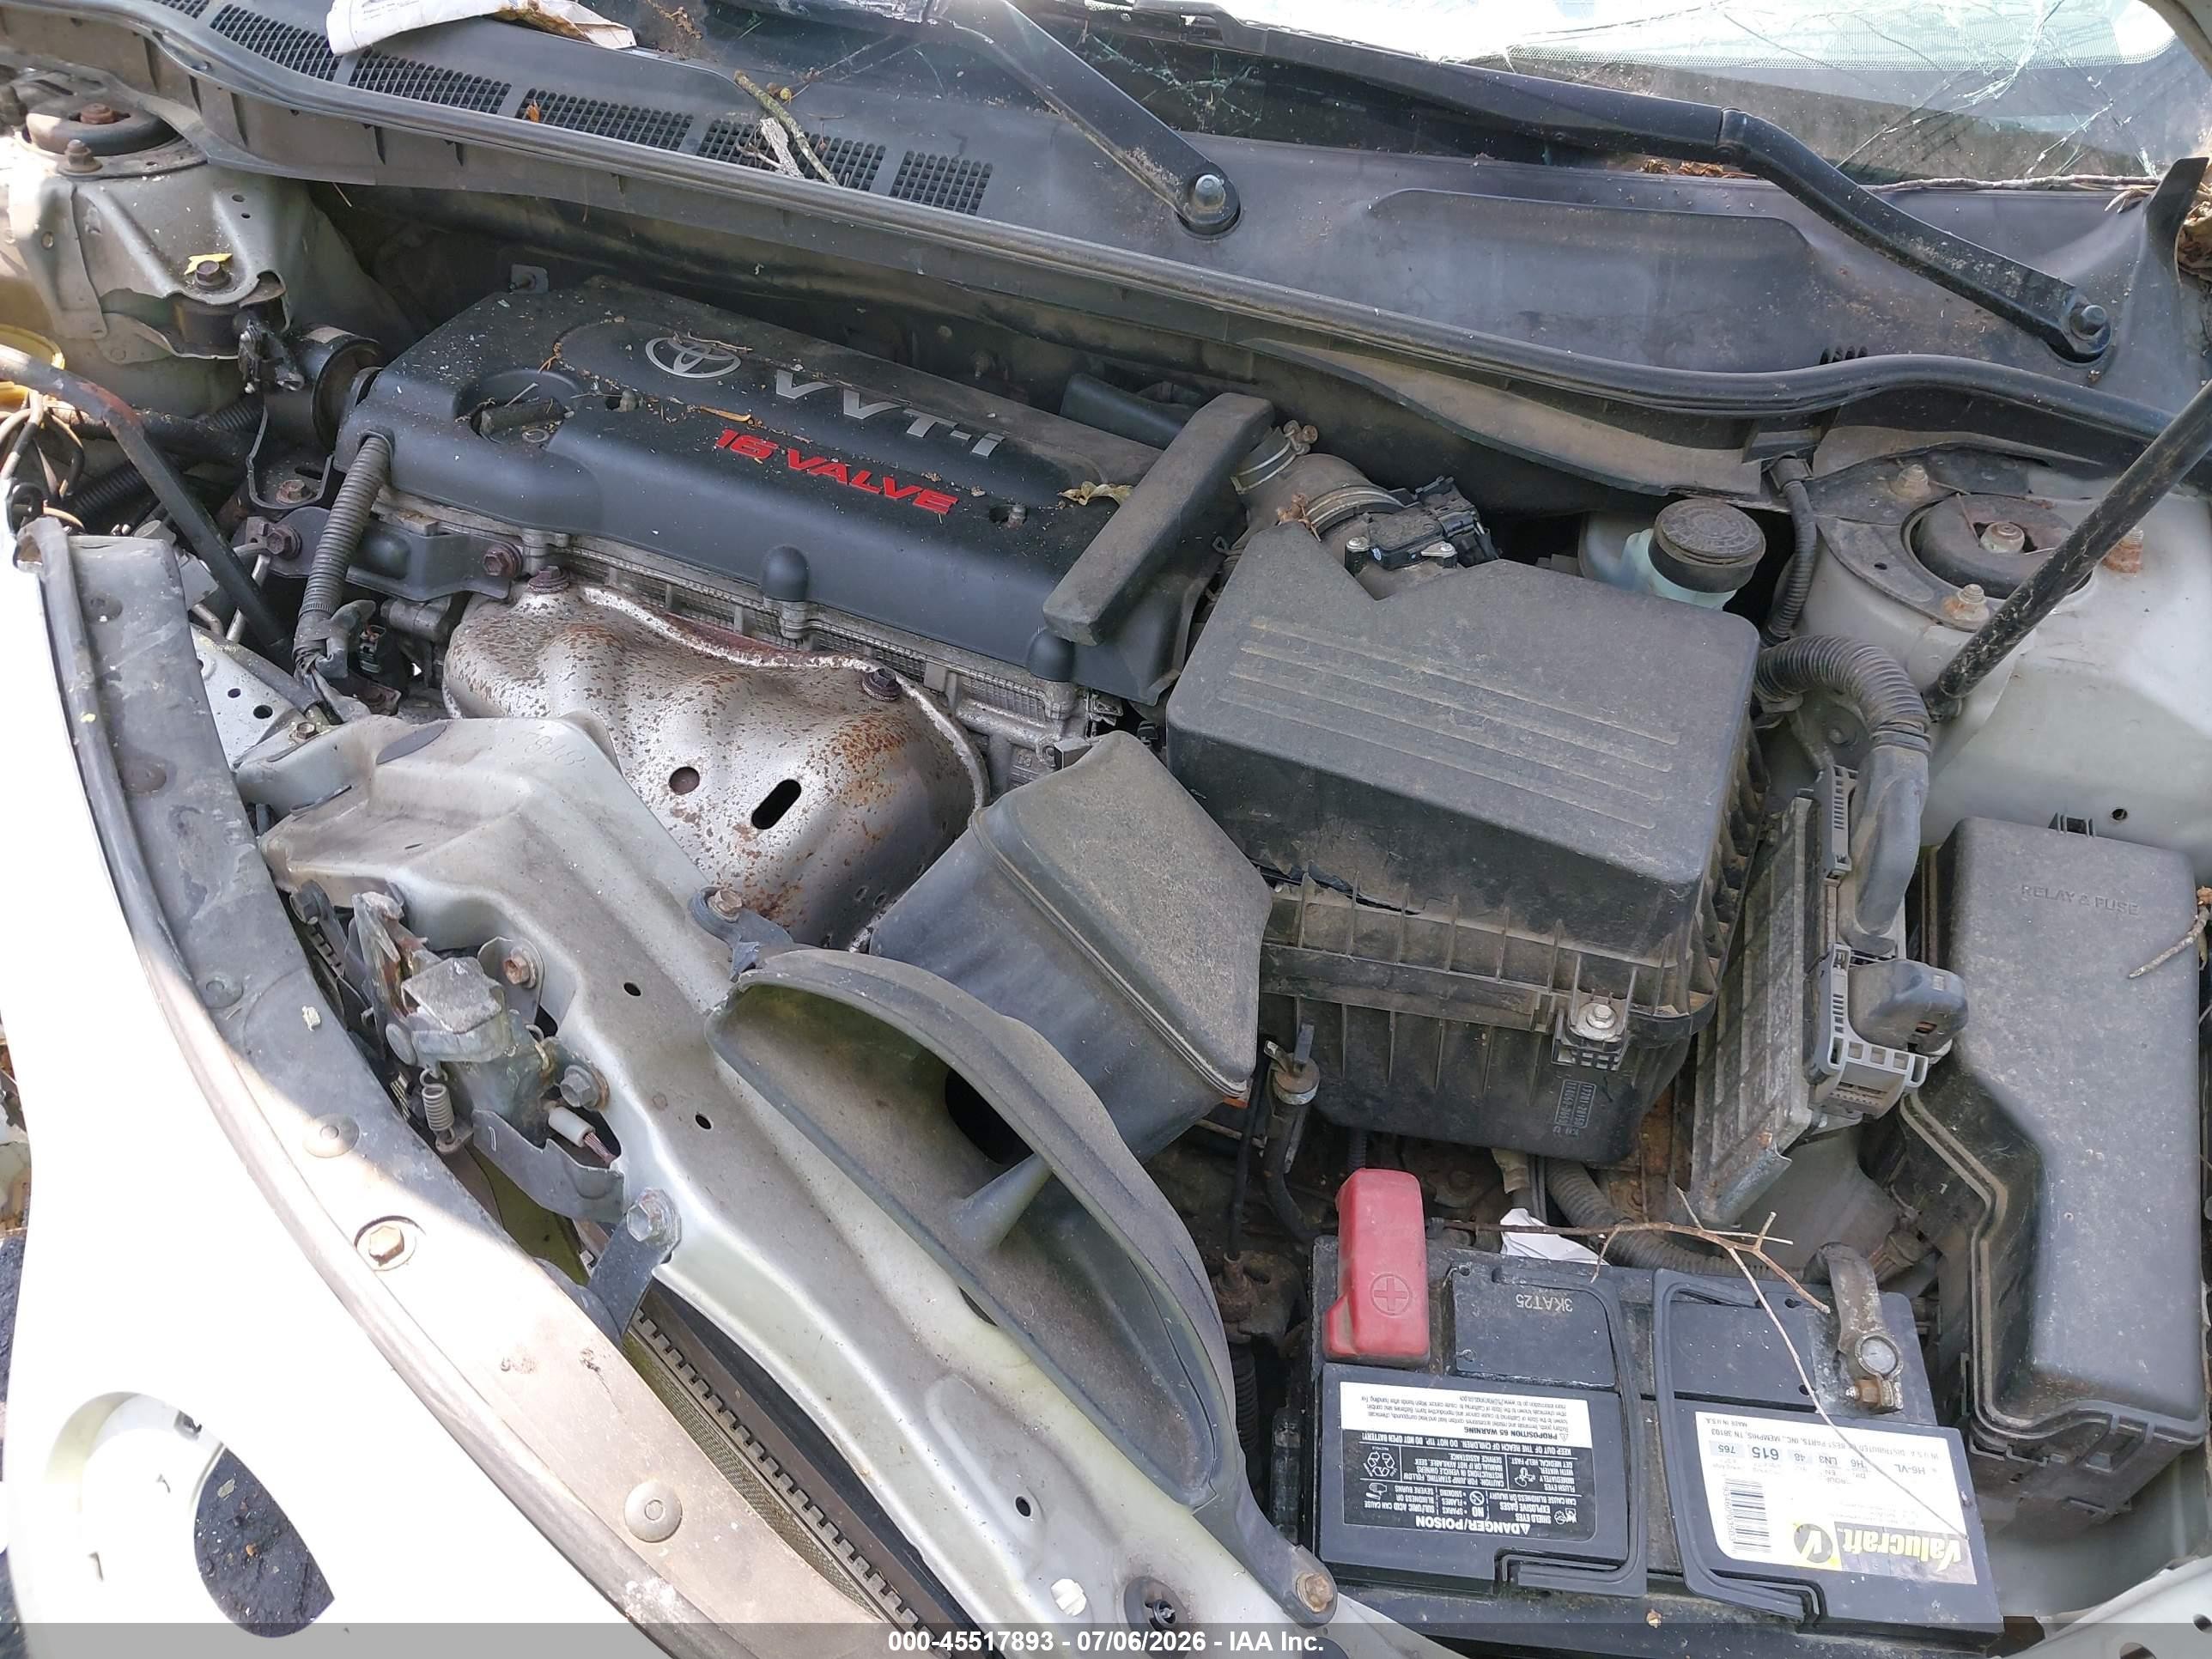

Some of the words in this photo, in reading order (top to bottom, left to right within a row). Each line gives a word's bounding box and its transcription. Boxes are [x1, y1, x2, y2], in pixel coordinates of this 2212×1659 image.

[714, 428, 778, 459] 16
[787, 447, 958, 514] VALVE
[2021, 884, 2075, 902] RELAY
[2095, 896, 2141, 916] FUSE
[1516, 1293, 1573, 1312] 3KAT25
[1463, 1426, 1498, 1435] WARNING
[1362, 1432, 1388, 1441] BATTERY!
[1389, 1434, 1403, 1443] OPEN
[1404, 1436, 1414, 1444] NOT
[1511, 1431, 1558, 1440] PROPOSITION
[1461, 1441, 1491, 1449] CHILDREN.
[1501, 1443, 1520, 1451] REACH
[1801, 1437, 1826, 1448] PARTS,
[1522, 1444, 1533, 1453] THE
[1544, 1446, 1556, 1455] OUT
[1556, 1448, 1571, 1456] KEEP
[1717, 1444, 1736, 1454] 765
[1859, 1444, 1905, 1456] DISTRIBUTED
[1448, 1453, 1480, 1462] ASSISTANCE.
[1752, 1446, 1779, 1461] 615
[1794, 1453, 1805, 1462] 48
[1819, 1455, 1838, 1466] LN3
[1850, 1459, 1864, 1468] H6
[1417, 1465, 1437, 1474] OWNERS
[1893, 1463, 1925, 1475] H6-VL
[1403, 1472, 1424, 1480] FOLLOW
[1467, 1470, 1504, 1479] INSTRUCTIONS
[1453, 1476, 1467, 1485] JUMP
[1480, 1479, 1504, 1487] CAUTION:
[1539, 1475, 1575, 1484] IMMEDIATELY
[1413, 1486, 1434, 1495] SEVERE
[1439, 1489, 1462, 1498] SMOKING
[1405, 1494, 1434, 1504] BLINDNESS
[1441, 1498, 1462, 1506] FLAMES
[1518, 1494, 1547, 1503] BLINDNESS
[1547, 1496, 1565, 1504] CAUSE
[1381, 1501, 1392, 1510] CAN
[1393, 1503, 1407, 1511] ACID
[1408, 1504, 1434, 1514] SULFURIC
[1499, 1501, 1518, 1511] GASES
[1518, 1504, 1550, 1513] EXPLOSIVE
[1442, 1506, 1463, 1516] SPARKS
[1472, 1506, 1484, 1517] NO
[1515, 1513, 1530, 1522] EYES
[1530, 1515, 1552, 1524] SHIELD
[1415, 1515, 1520, 1535] DANGER/POISON
